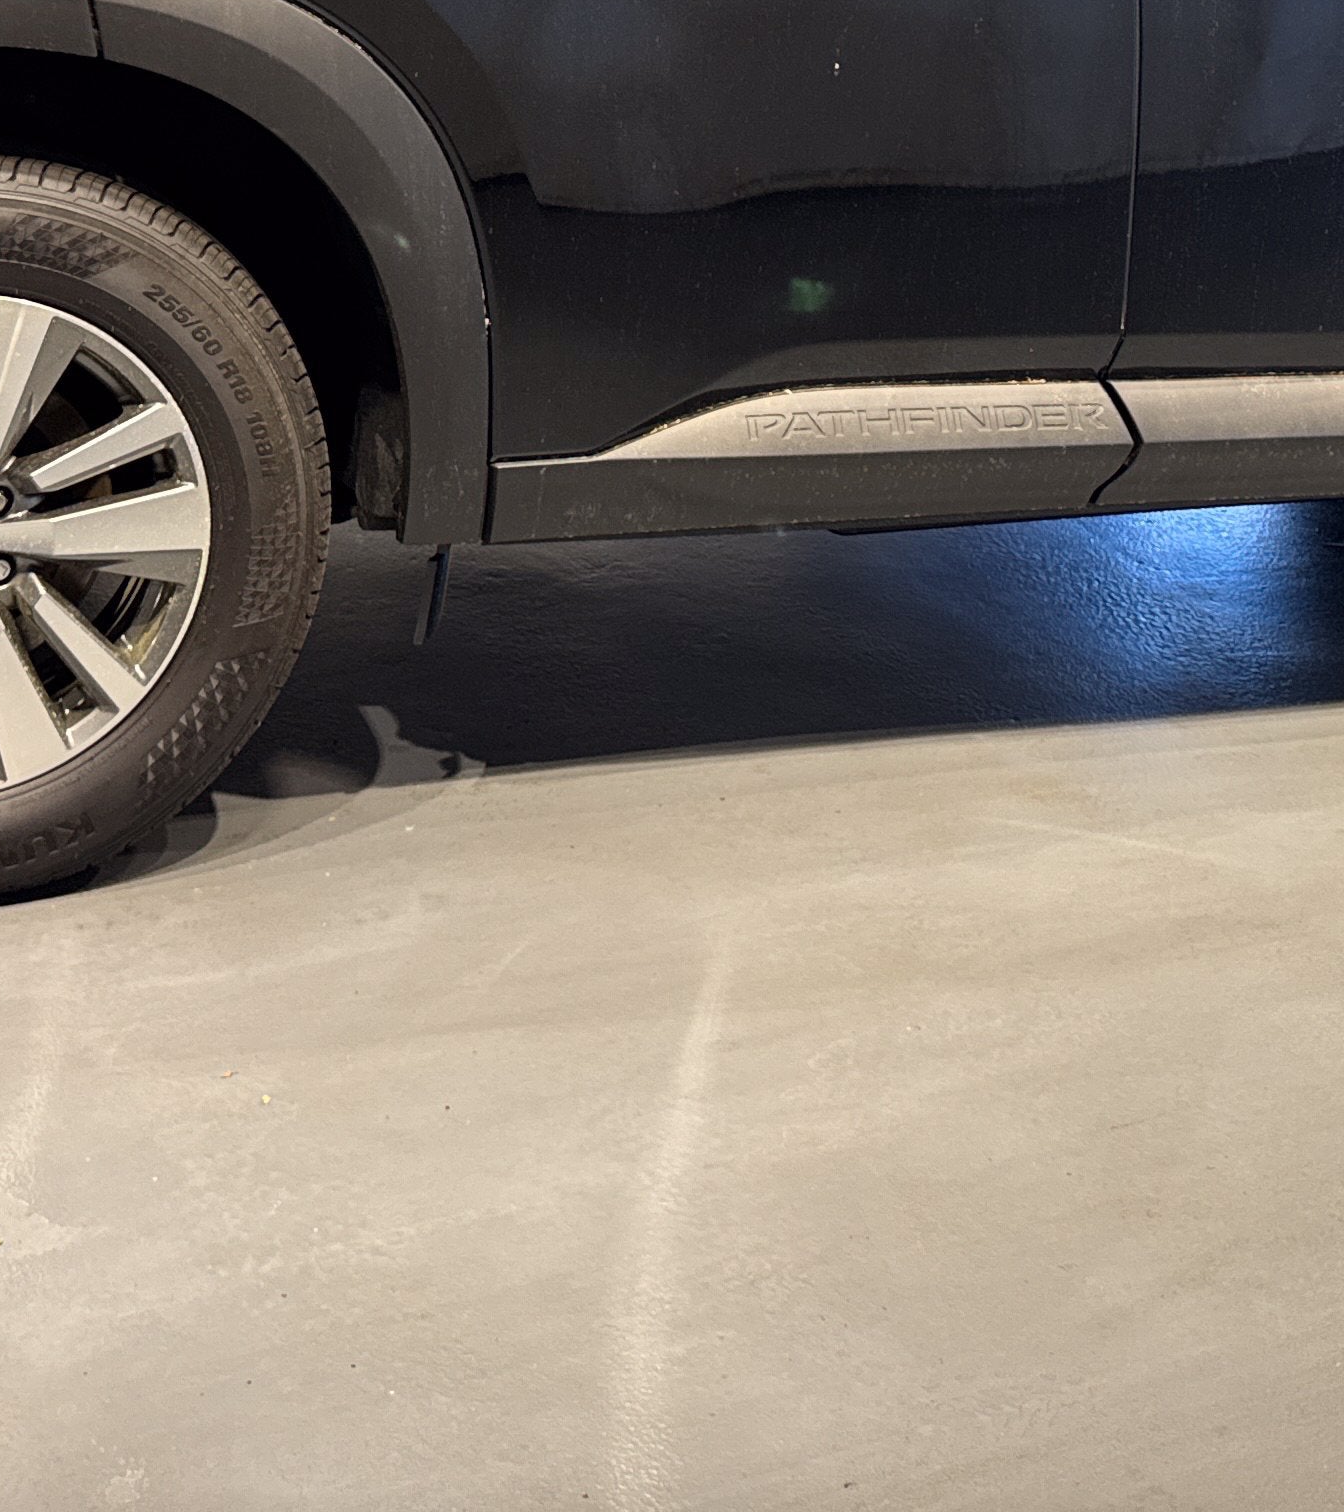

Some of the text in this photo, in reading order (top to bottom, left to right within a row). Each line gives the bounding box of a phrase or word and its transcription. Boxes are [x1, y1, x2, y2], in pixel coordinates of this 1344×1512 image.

[142, 283, 280, 476] 255/60 R18 108H
[745, 402, 1108, 442] PATHFINDER
